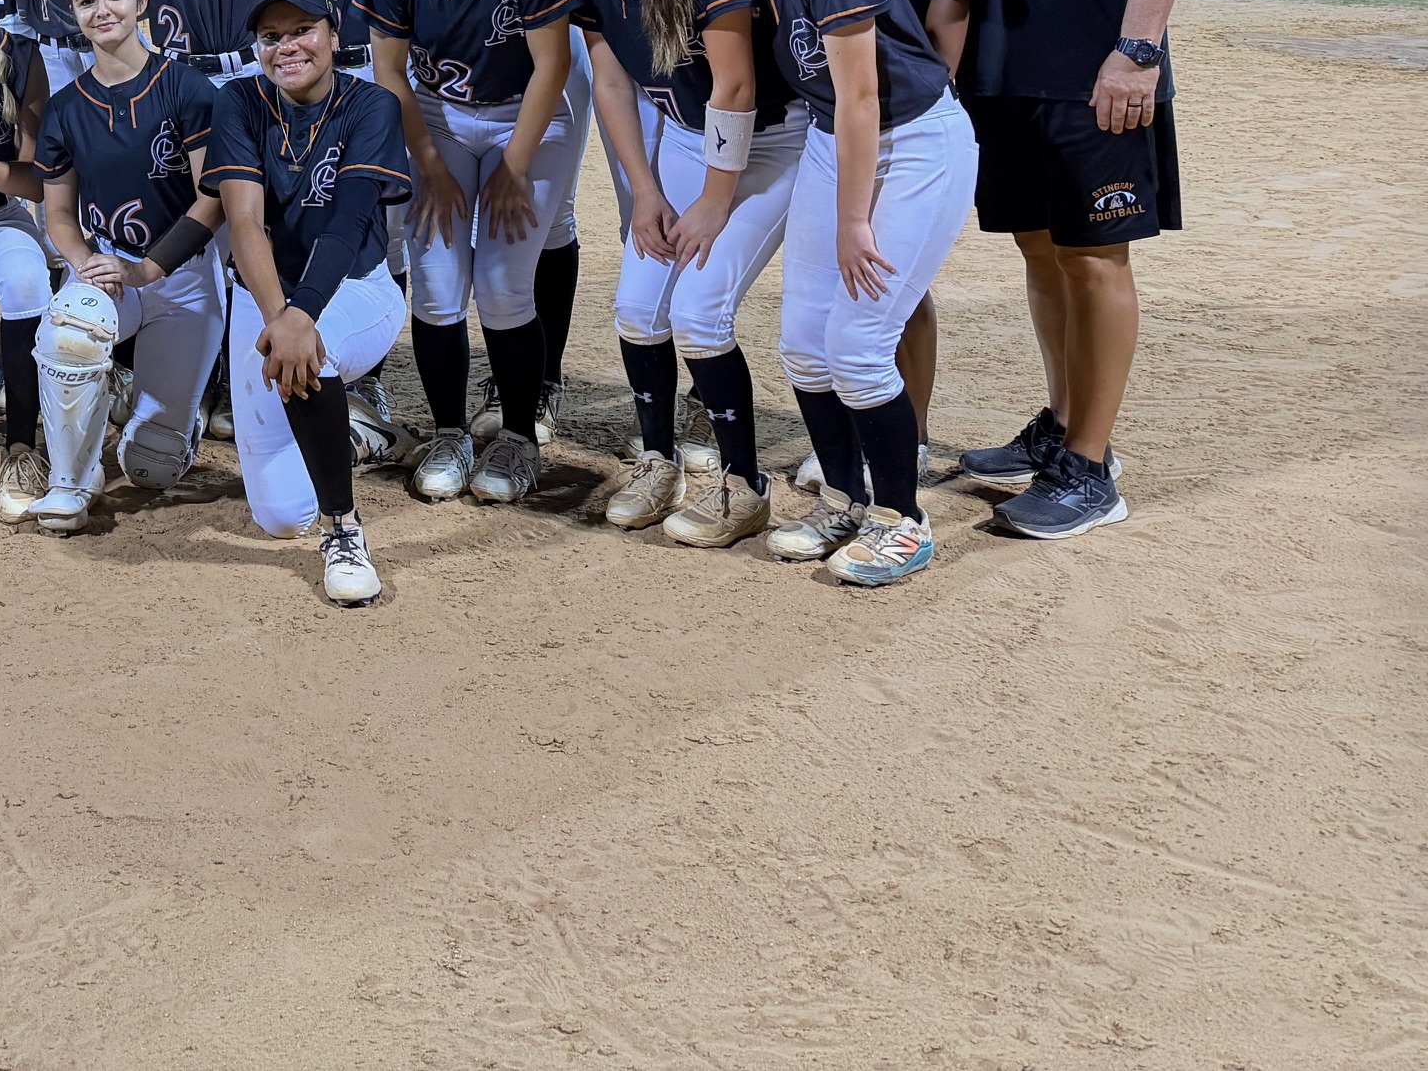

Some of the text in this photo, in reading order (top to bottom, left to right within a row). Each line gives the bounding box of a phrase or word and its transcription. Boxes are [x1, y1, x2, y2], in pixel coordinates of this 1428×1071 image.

[158, 4, 192, 54] 2
[411, 45, 474, 103] 32
[1091, 182, 1135, 199] STINGRAY
[1088, 204, 1146, 222] FOOTBALL
